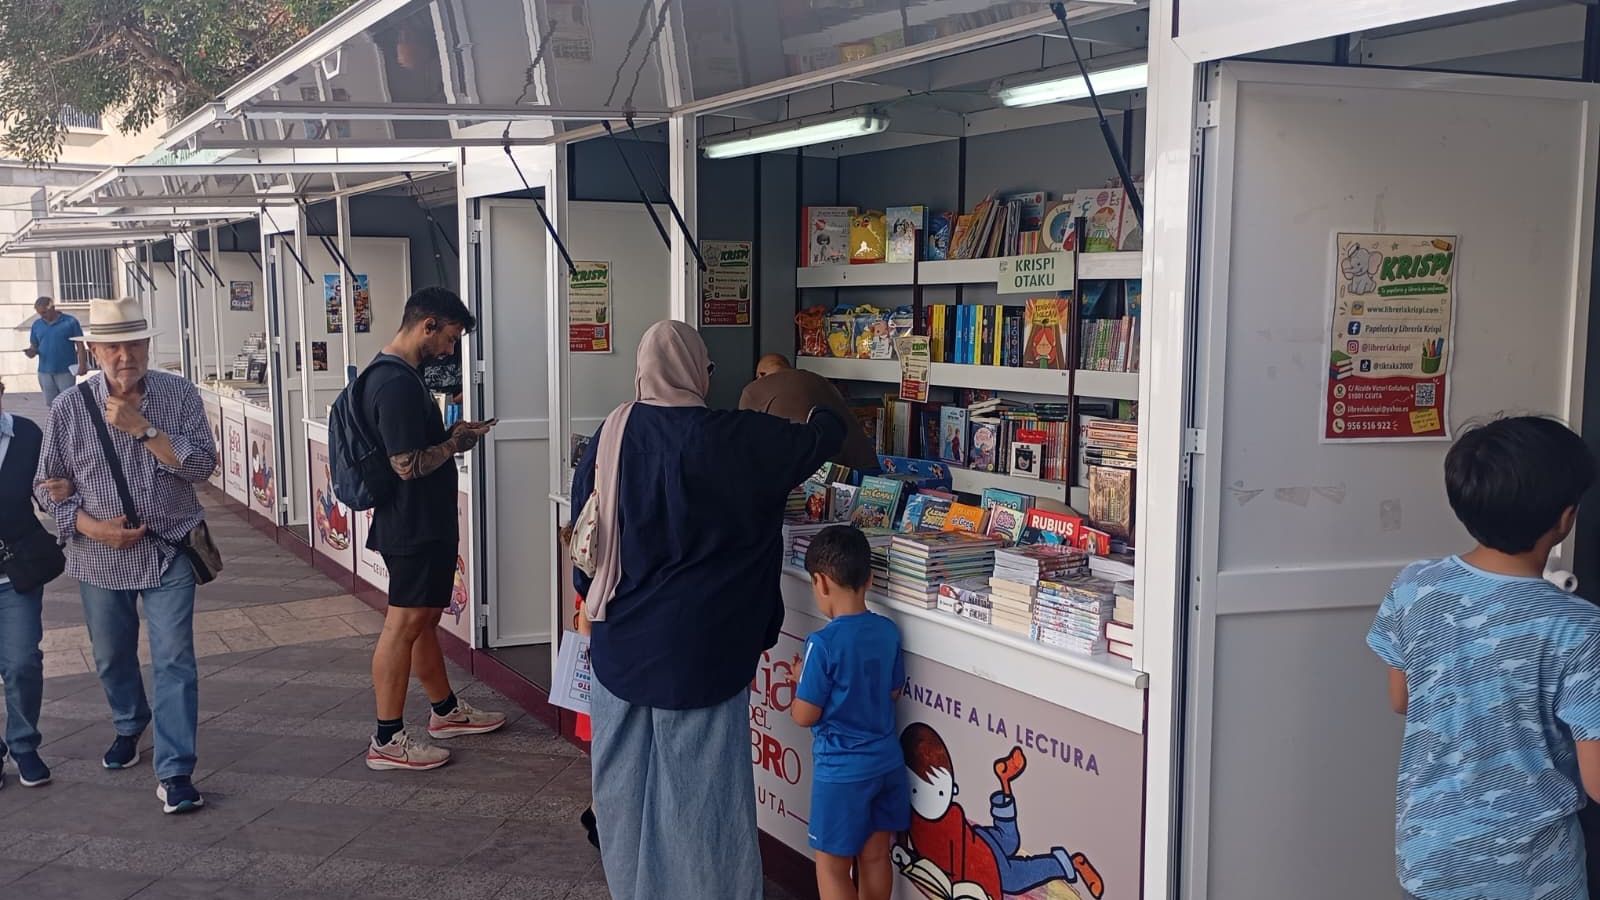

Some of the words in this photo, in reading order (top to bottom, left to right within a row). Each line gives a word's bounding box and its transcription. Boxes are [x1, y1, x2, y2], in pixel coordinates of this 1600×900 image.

[1015, 257, 1055, 272] KRISPI
[1380, 252, 1453, 281] KRISPI
[1014, 273, 1055, 288] OTAKU
[1031, 515, 1074, 536] RUBIUS
[901, 677, 961, 719] ÁNZATE
[968, 707, 980, 727] A
[987, 713, 1008, 738] LA
[1016, 724, 1100, 776] LECTURA
[751, 728, 802, 785] BRO
[758, 788, 786, 818] UTA
